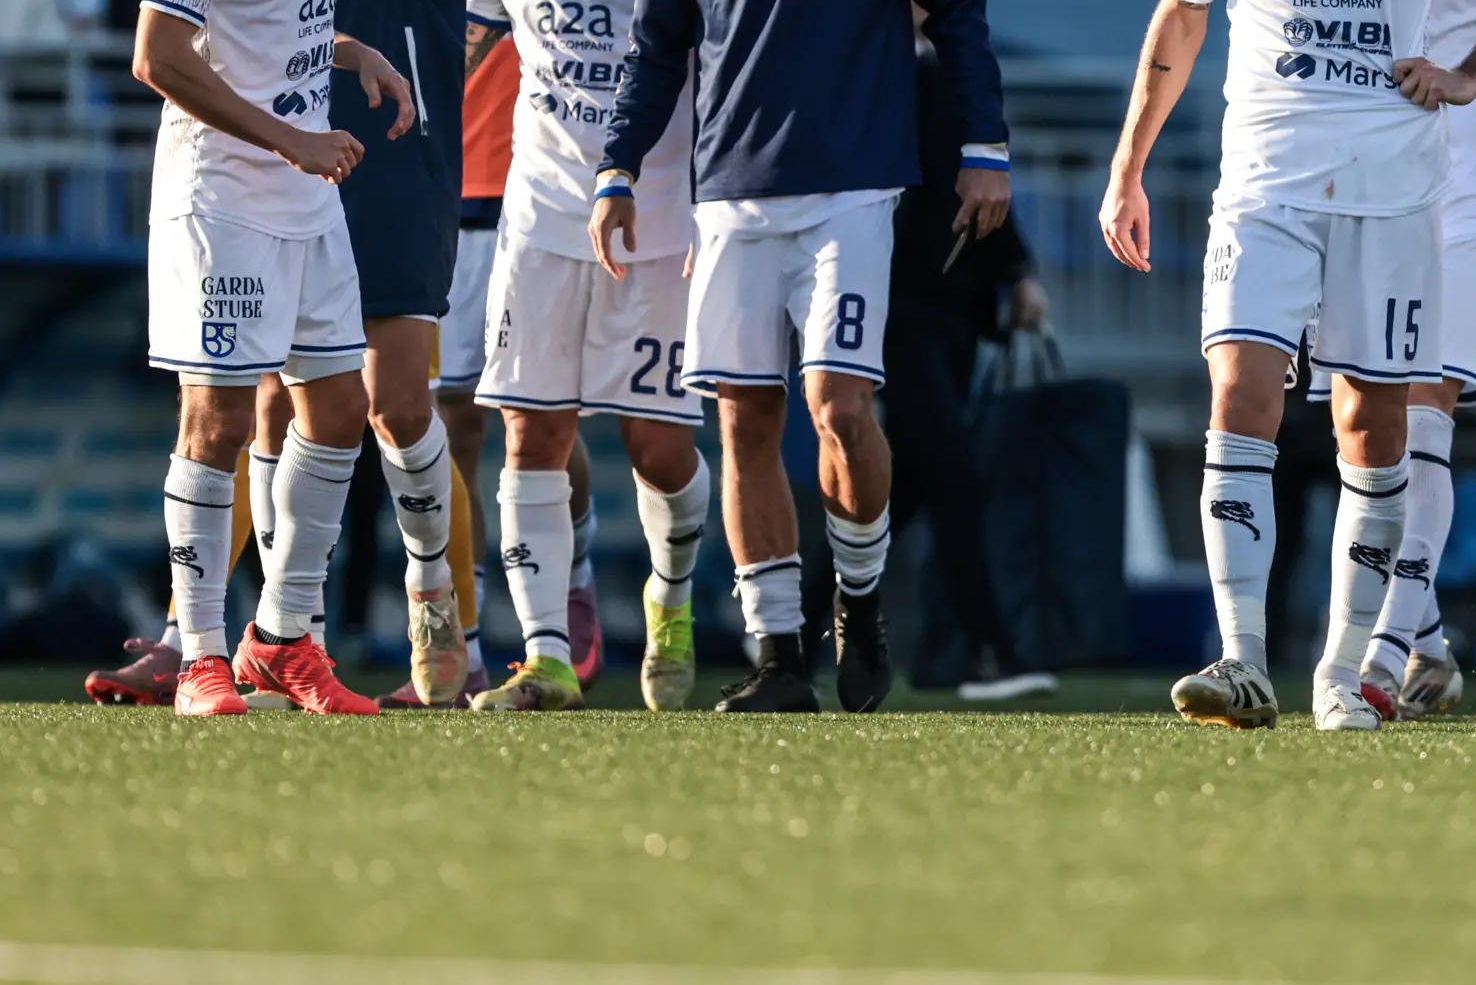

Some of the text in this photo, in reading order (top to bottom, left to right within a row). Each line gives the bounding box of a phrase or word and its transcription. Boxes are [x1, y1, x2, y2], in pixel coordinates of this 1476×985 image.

[298, 25, 313, 39] LIFE
[536, 1, 615, 38] a2a
[558, 40, 615, 52] COMPANY
[201, 276, 265, 296] GARDA
[203, 299, 263, 319] STUBE
[835, 292, 866, 350] 8
[1385, 297, 1422, 361] 15
[630, 336, 687, 398] 28
